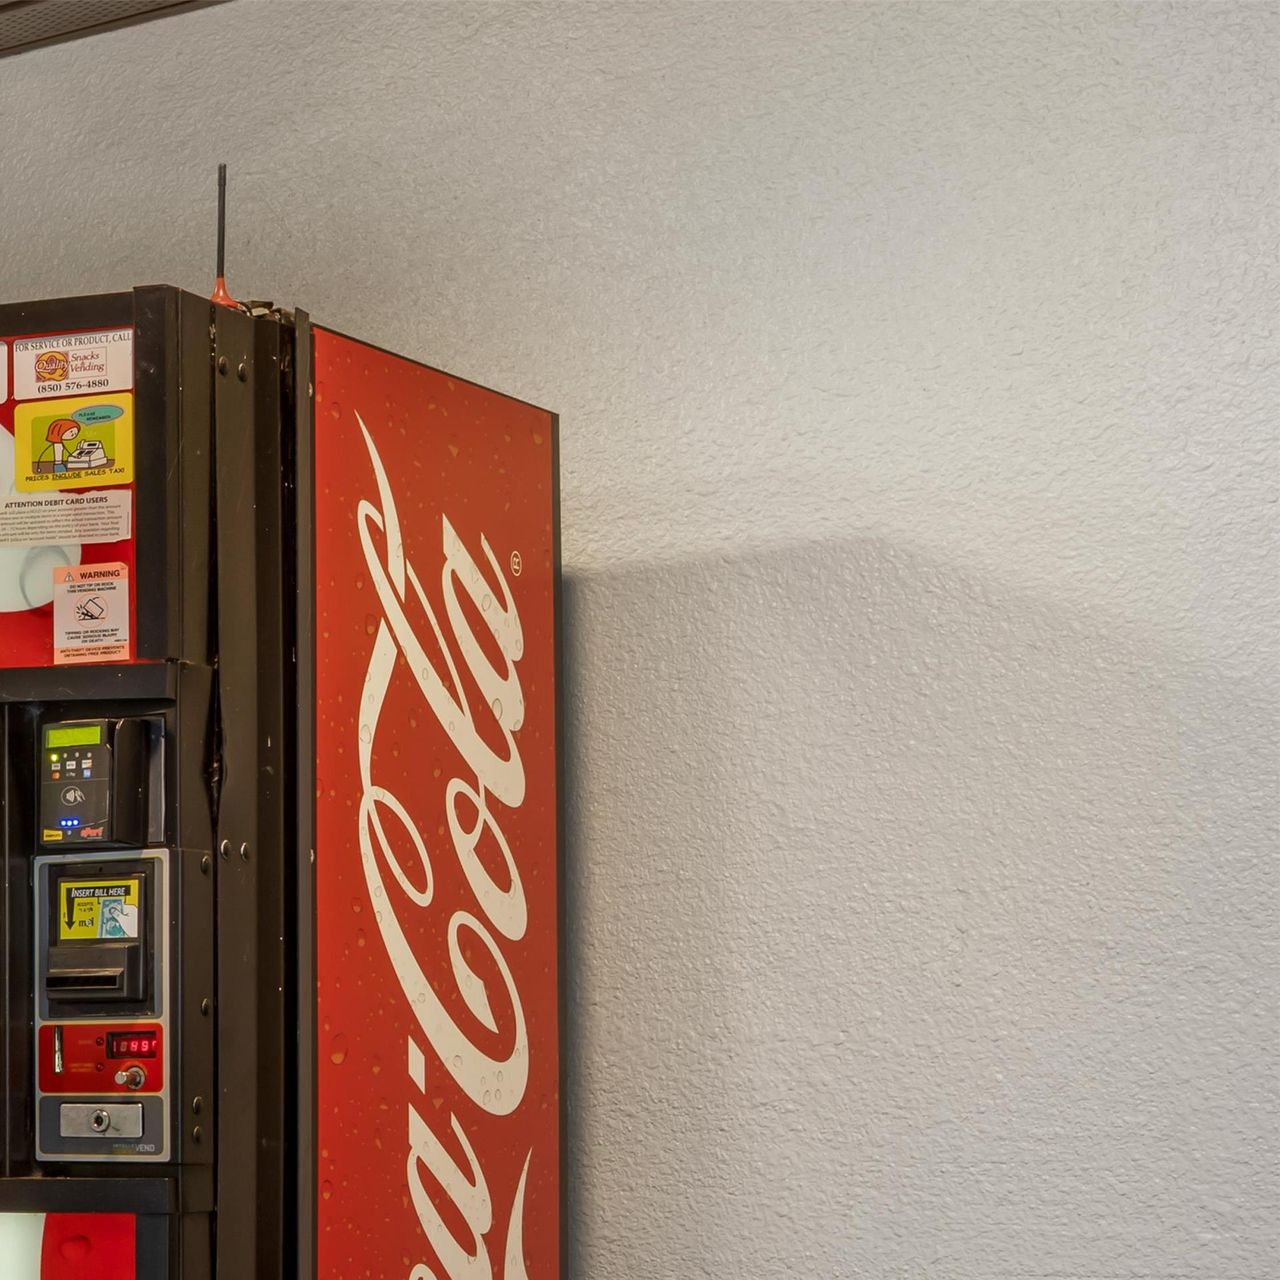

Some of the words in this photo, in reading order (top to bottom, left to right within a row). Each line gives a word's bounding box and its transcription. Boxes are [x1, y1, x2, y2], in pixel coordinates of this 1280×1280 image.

[15, 343, 29, 352] FOR
[30, 339, 60, 351] SERVICE
[61, 338, 73, 348] OR
[74, 335, 111, 348] PRODUCT,
[112, 332, 132, 345] CALL
[71, 351, 100, 361] Snacks
[34, 357, 71, 373] Quality
[70, 361, 105, 372] Vending
[37, 383, 62, 394] (850)
[64, 379, 109, 391] 576-4880
[25, 473, 49, 482] PRICES
[52, 471, 82, 481] INCLUDE
[84, 469, 106, 477] SALES
[4, 500, 43, 509] ATTENTION
[44, 499, 64, 507] DEBIT
[86, 496, 108, 504] USERS
[80, 569, 120, 579] WARNING
[71, 888, 94, 898] INSERT
[95, 888, 108, 896] BILL
[108, 887, 126, 896] HERE
[135, 1143, 155, 1152] VEND
